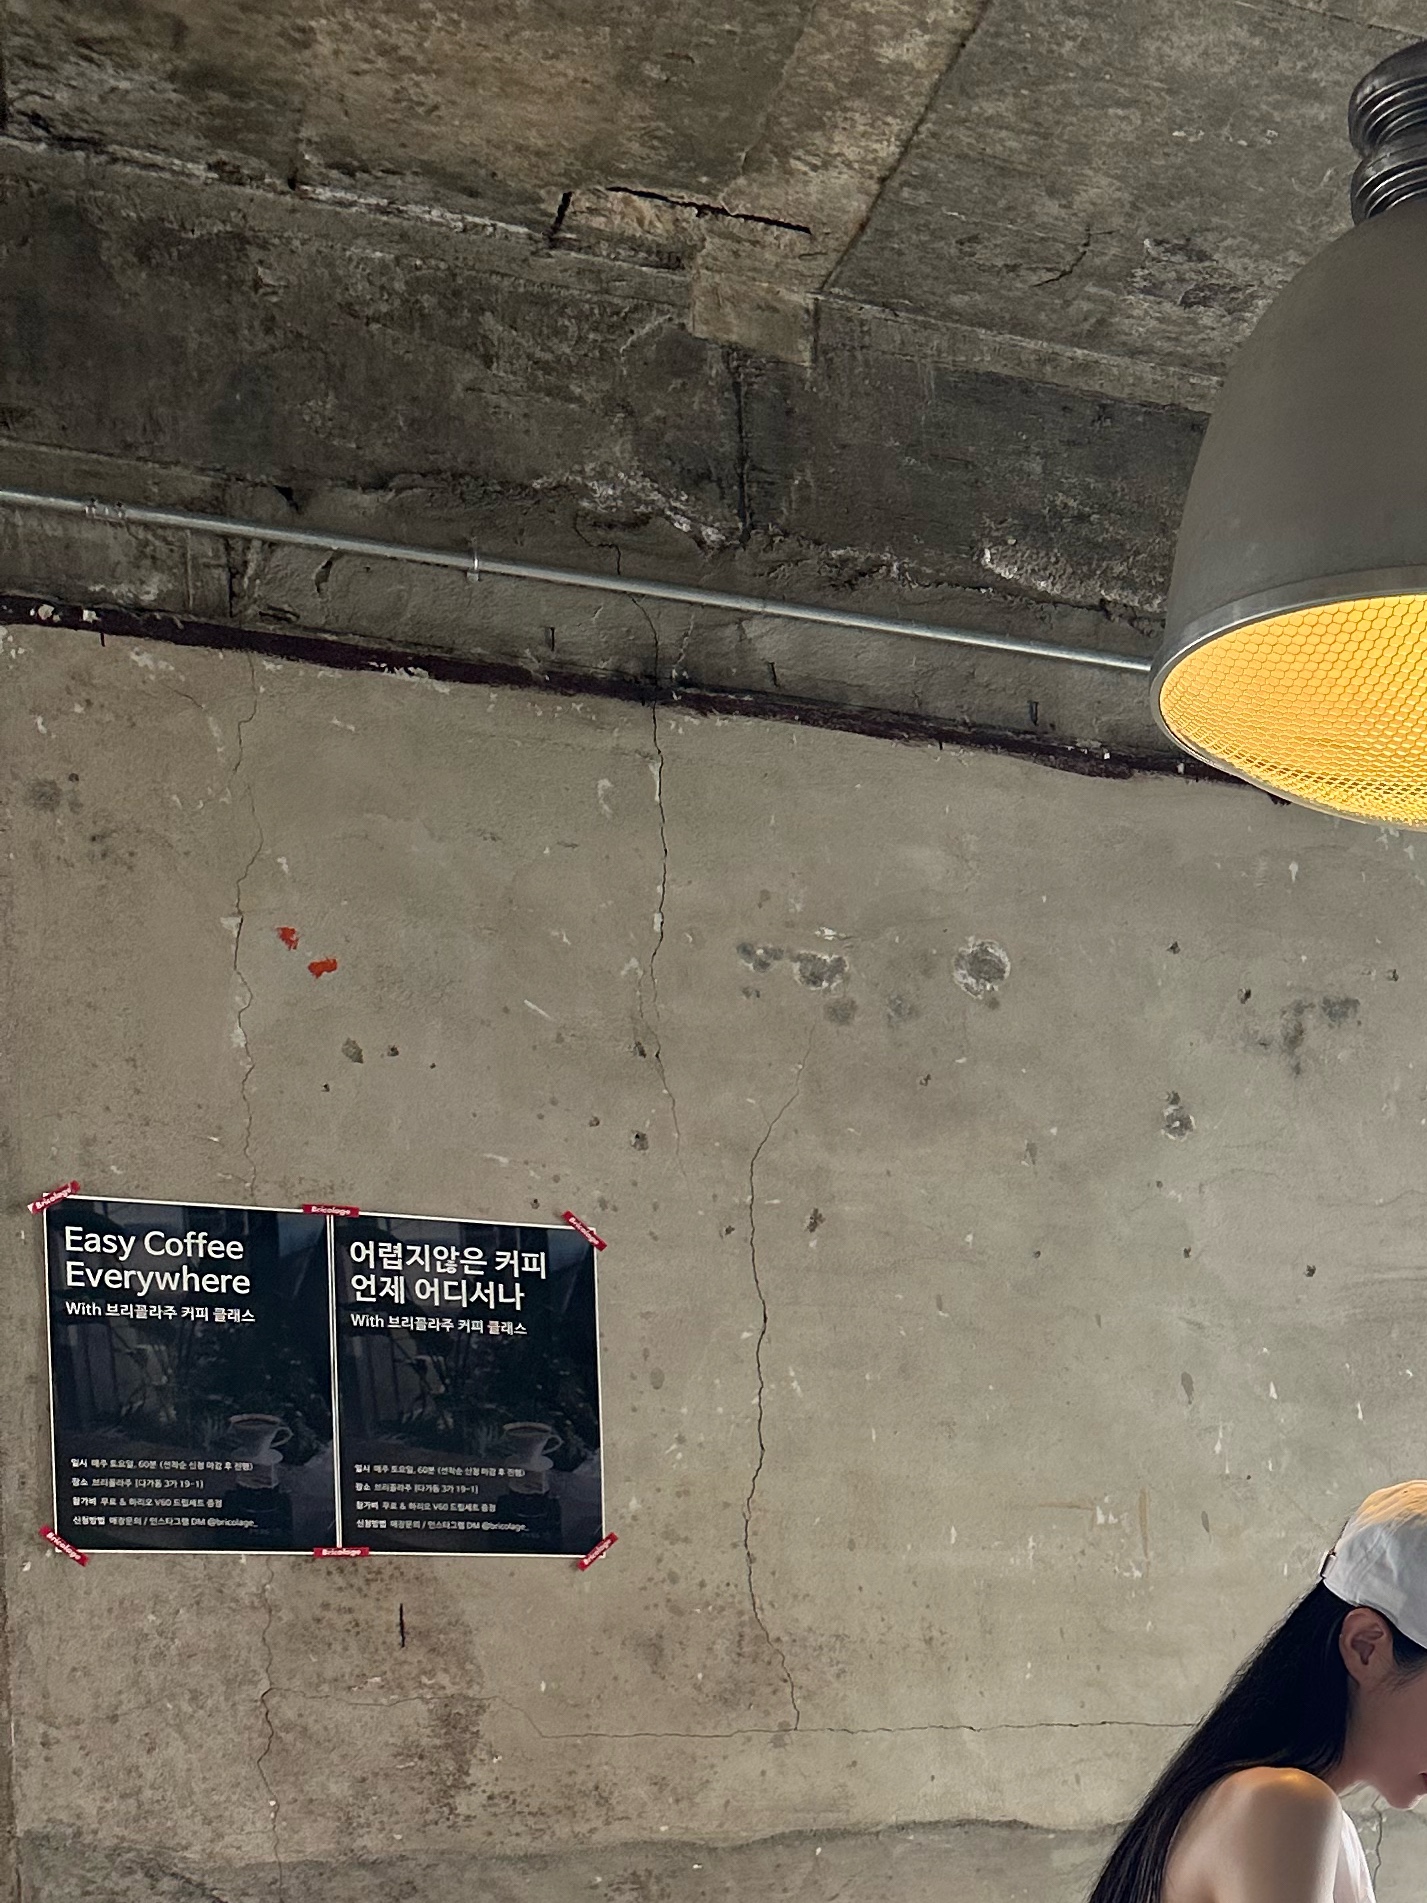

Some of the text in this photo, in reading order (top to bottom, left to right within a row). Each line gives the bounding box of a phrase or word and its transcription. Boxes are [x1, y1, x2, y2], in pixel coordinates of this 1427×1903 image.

[311, 1205, 351, 1216] Bricolage
[64, 1225, 244, 1262] Easy Coffee
[350, 1240, 547, 1280] 어렵지않은 커피
[65, 1260, 251, 1297] Everywhere
[350, 1274, 526, 1311] 언제 어디서나
[65, 1301, 102, 1317] With
[180, 1306, 209, 1322] 커피
[212, 1307, 256, 1323] 클래스
[350, 1313, 385, 1328] With
[457, 1319, 484, 1334] 커피
[486, 1319, 528, 1336] 클래스
[71, 1458, 88, 1468] 일시
[71, 1477, 89, 1487] 장소
[119, 1497, 127, 1506] &
[143, 1516, 148, 1526] /
[190, 1517, 206, 1526] DM
[46, 1532, 81, 1560] Bricolage
